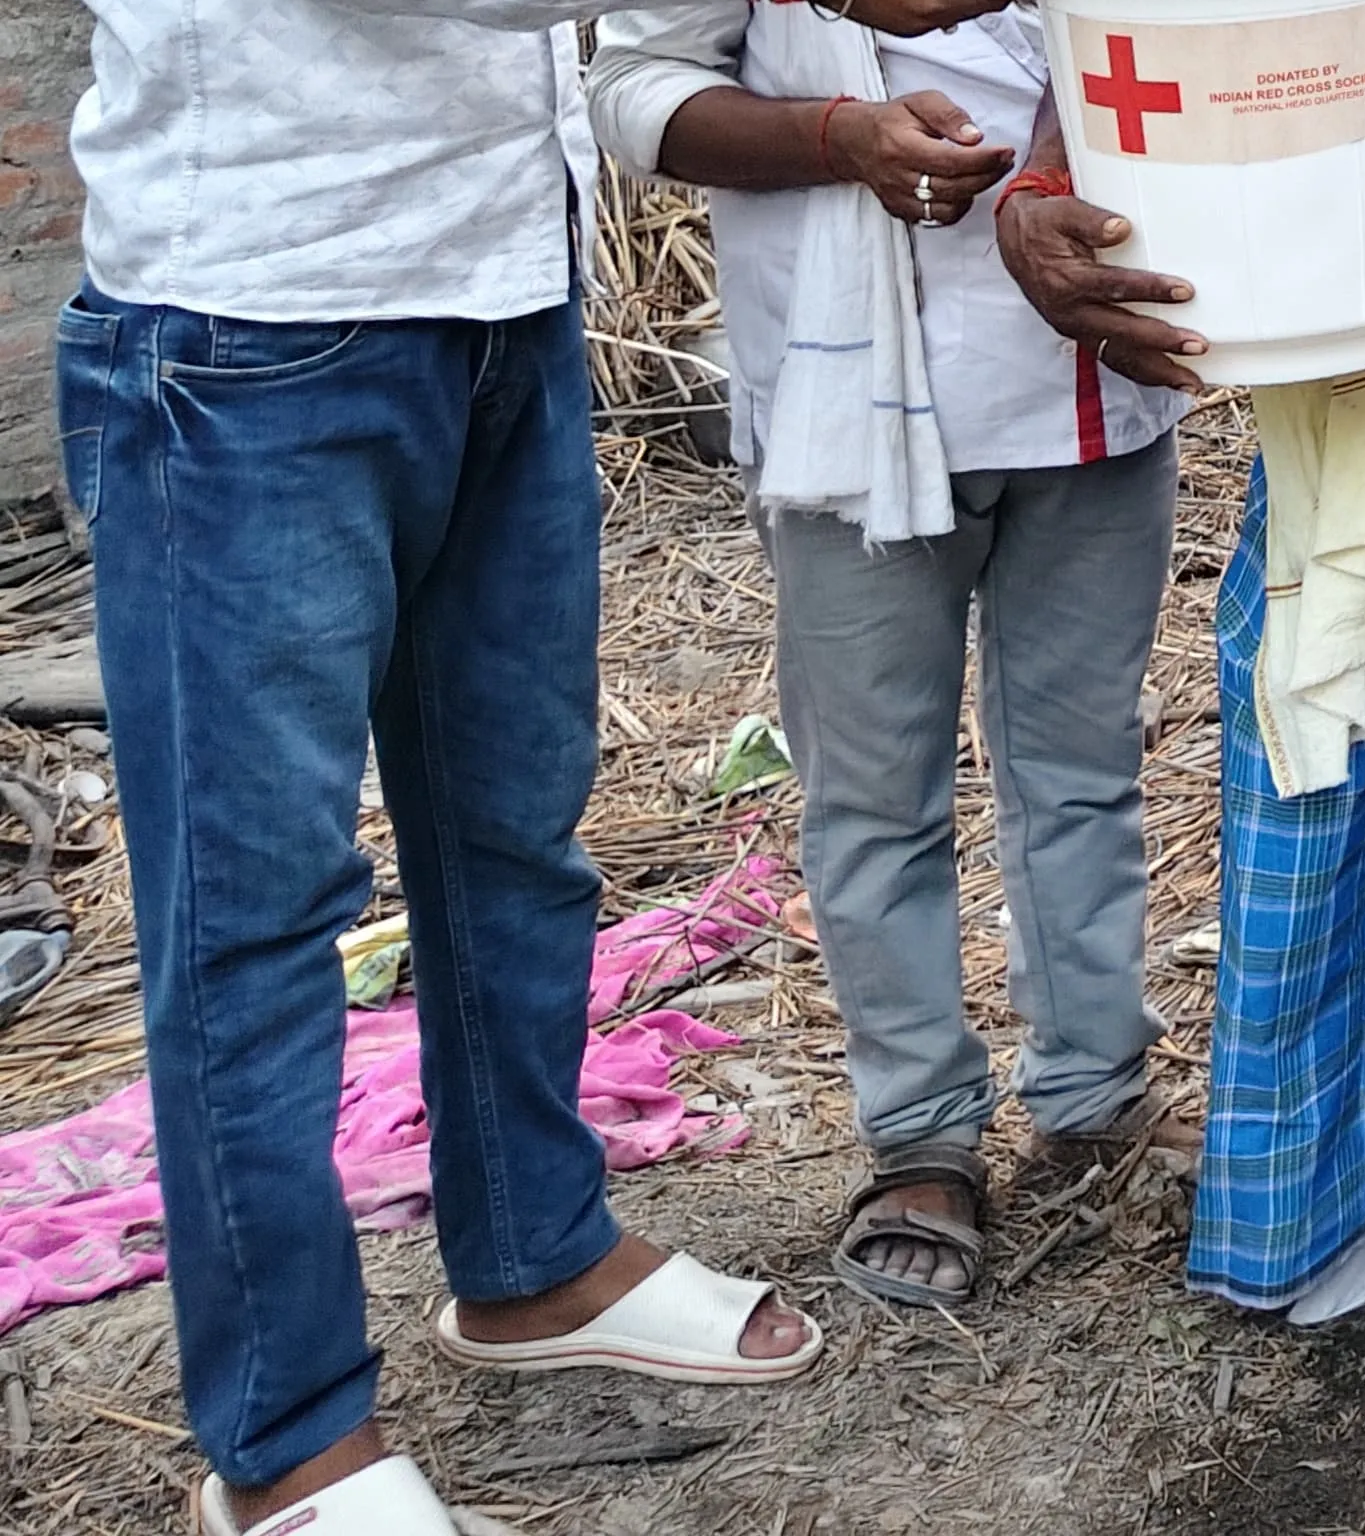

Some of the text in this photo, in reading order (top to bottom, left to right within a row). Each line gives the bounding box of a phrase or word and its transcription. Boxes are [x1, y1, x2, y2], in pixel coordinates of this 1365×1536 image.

[1256, 63, 1340, 86] DONATED BY
[1209, 91, 1253, 104] INDIAN
[1256, 87, 1284, 101] RED
[1287, 79, 1332, 97] CROSS
[1232, 99, 1284, 115] (NATIONAL
[1285, 95, 1313, 110] HEAD
